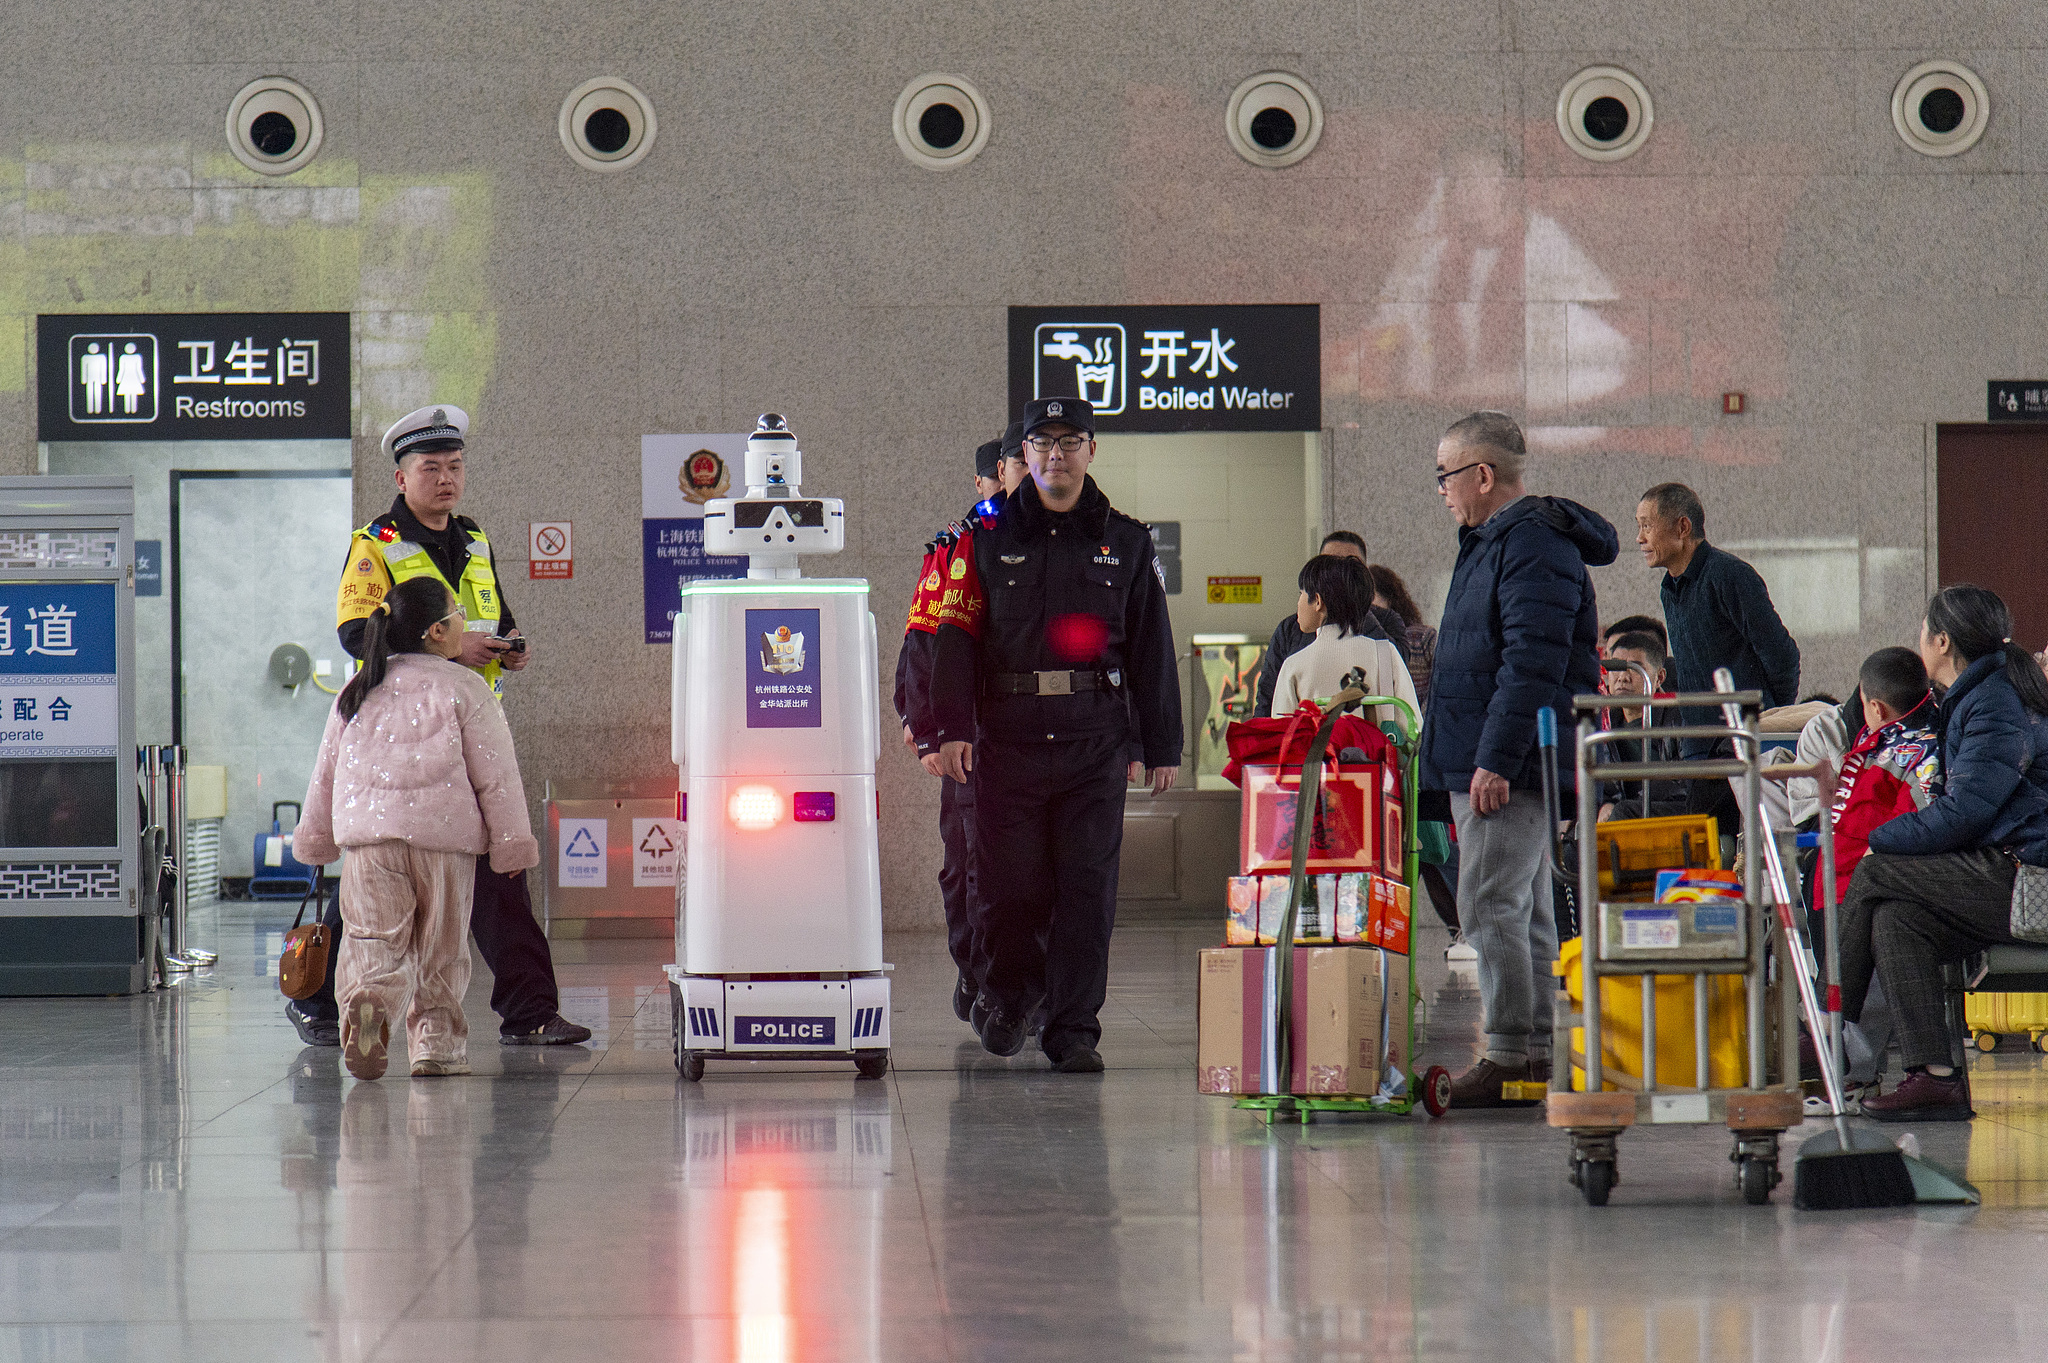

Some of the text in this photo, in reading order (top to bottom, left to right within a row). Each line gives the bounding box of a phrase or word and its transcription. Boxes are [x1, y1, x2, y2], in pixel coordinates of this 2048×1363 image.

[173, 337, 319, 386] 卫生间
[1140, 328, 1238, 378] 开水
[175, 396, 306, 418] Restrooms
[1139, 387, 1294, 410] Boiled Water
[673, 557, 738, 566] POLICE STATION
[1093, 556, 1120, 566] 087128
[343, 582, 383, 599] 执勤
[755, 685, 813, 694] 杭州铁路公安处
[0, 696, 72, 721] 配合
[759, 699, 809, 709] 金华站派出所
[750, 1023, 824, 1038] POLICE
